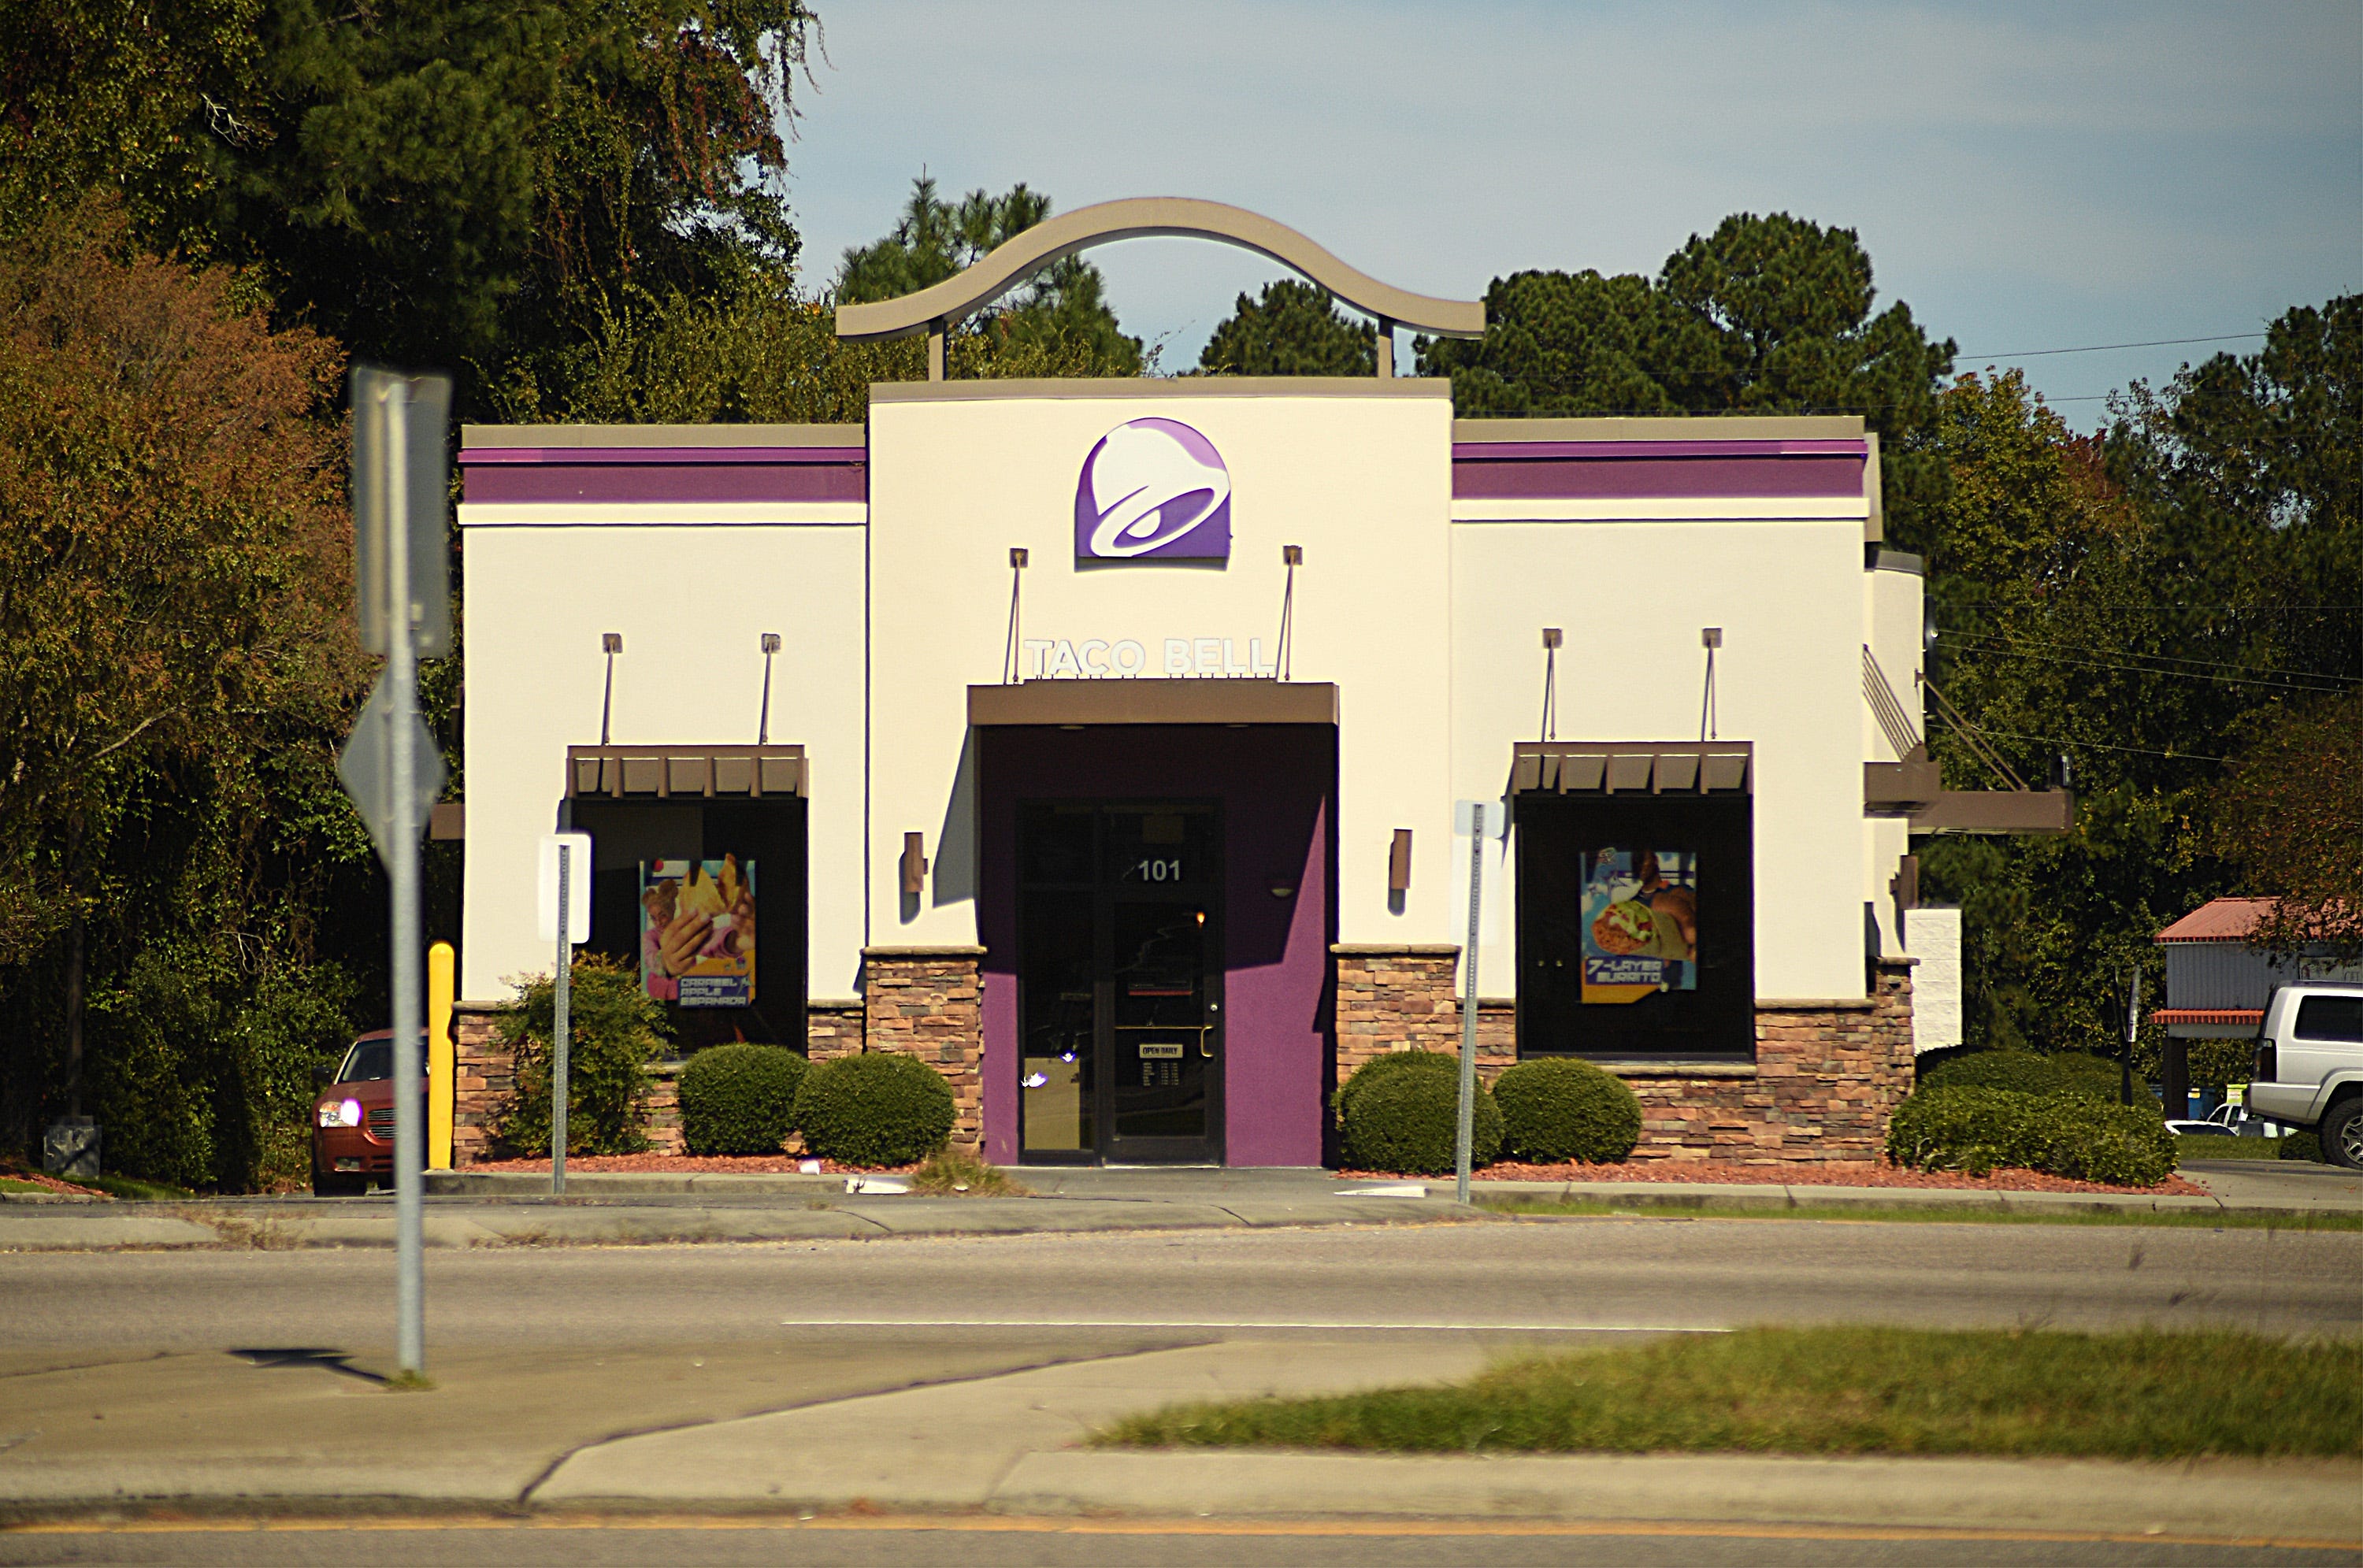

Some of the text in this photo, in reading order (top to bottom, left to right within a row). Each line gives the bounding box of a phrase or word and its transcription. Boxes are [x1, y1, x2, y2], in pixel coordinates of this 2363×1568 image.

[1024, 638, 1275, 676] TACO BELL
[1139, 860, 1180, 881] 101
[1597, 972, 1661, 982] BURRITO
